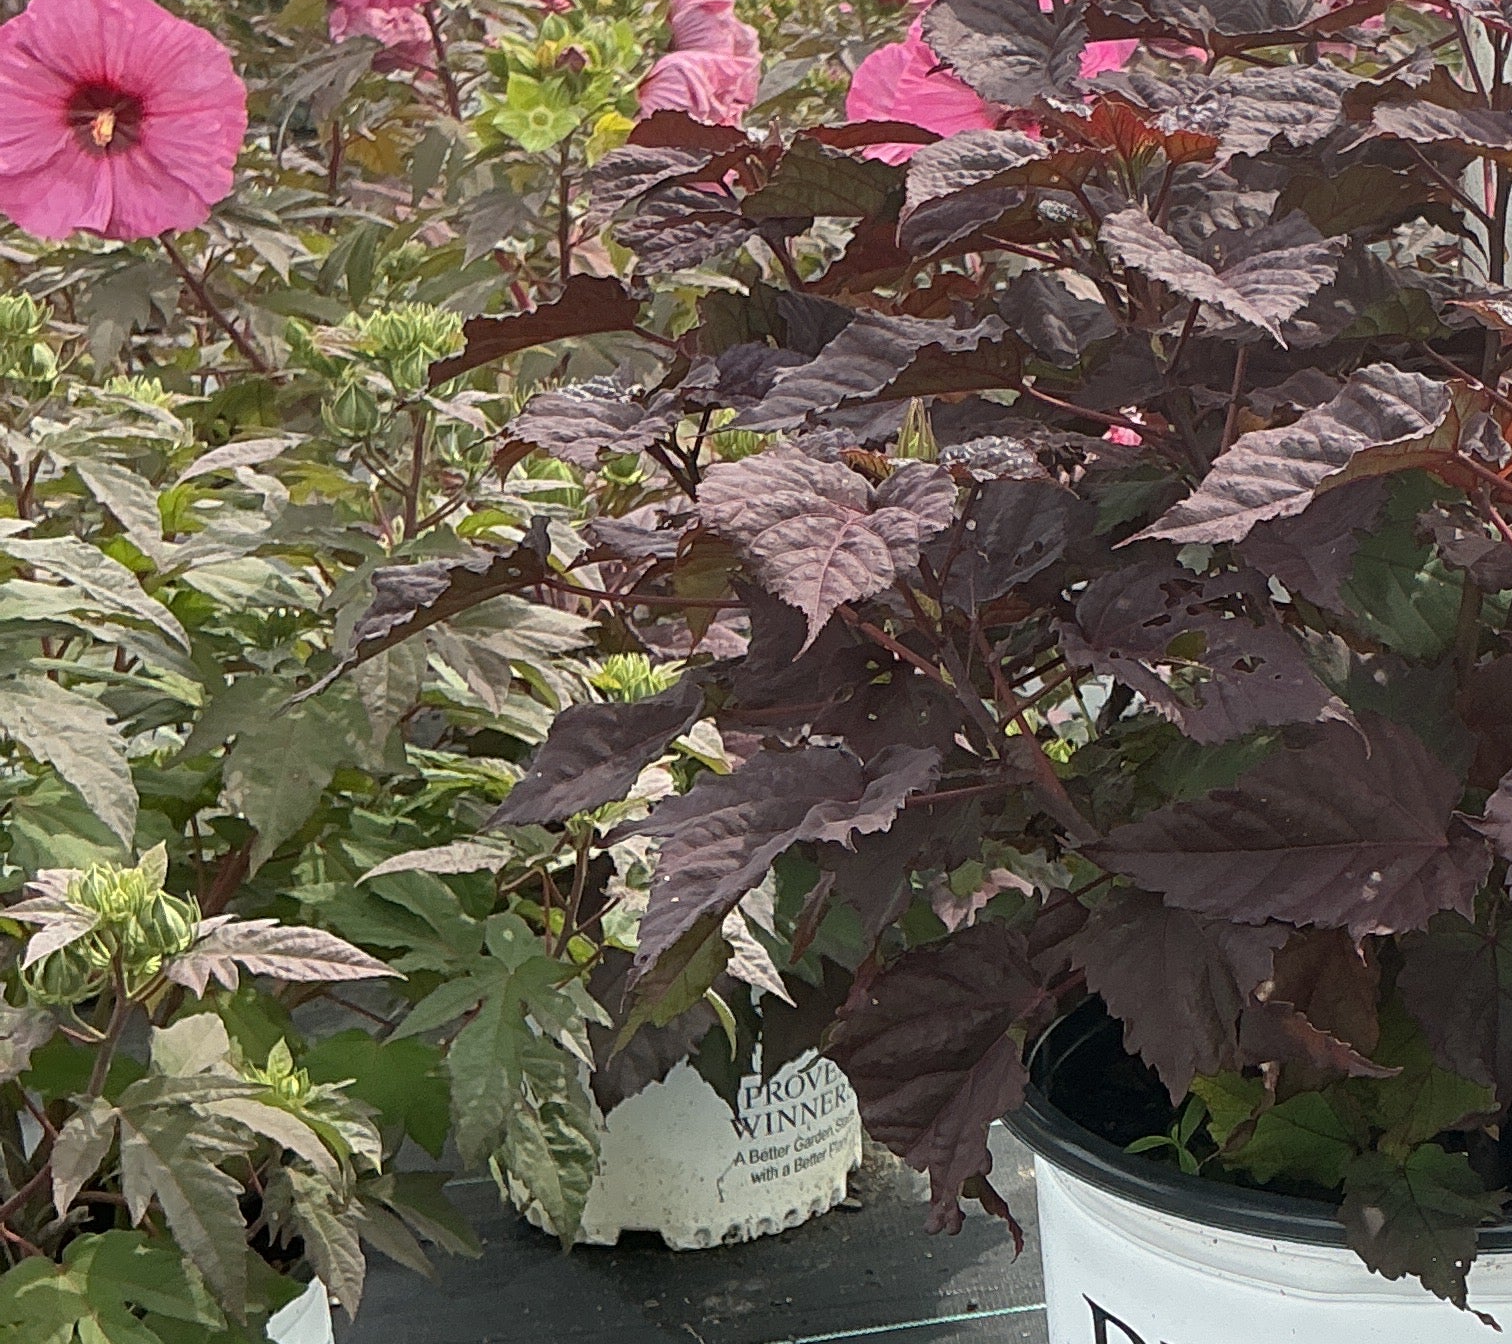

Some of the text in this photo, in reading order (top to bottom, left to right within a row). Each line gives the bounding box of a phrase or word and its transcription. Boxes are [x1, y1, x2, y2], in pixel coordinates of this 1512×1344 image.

[745, 1063, 841, 1109] PROVE
[730, 1083, 850, 1140] WINNER
[735, 1151, 745, 1166] A
[749, 1144, 790, 1164] Better
[750, 1167, 778, 1184] with
[794, 1149, 826, 1173] Better
